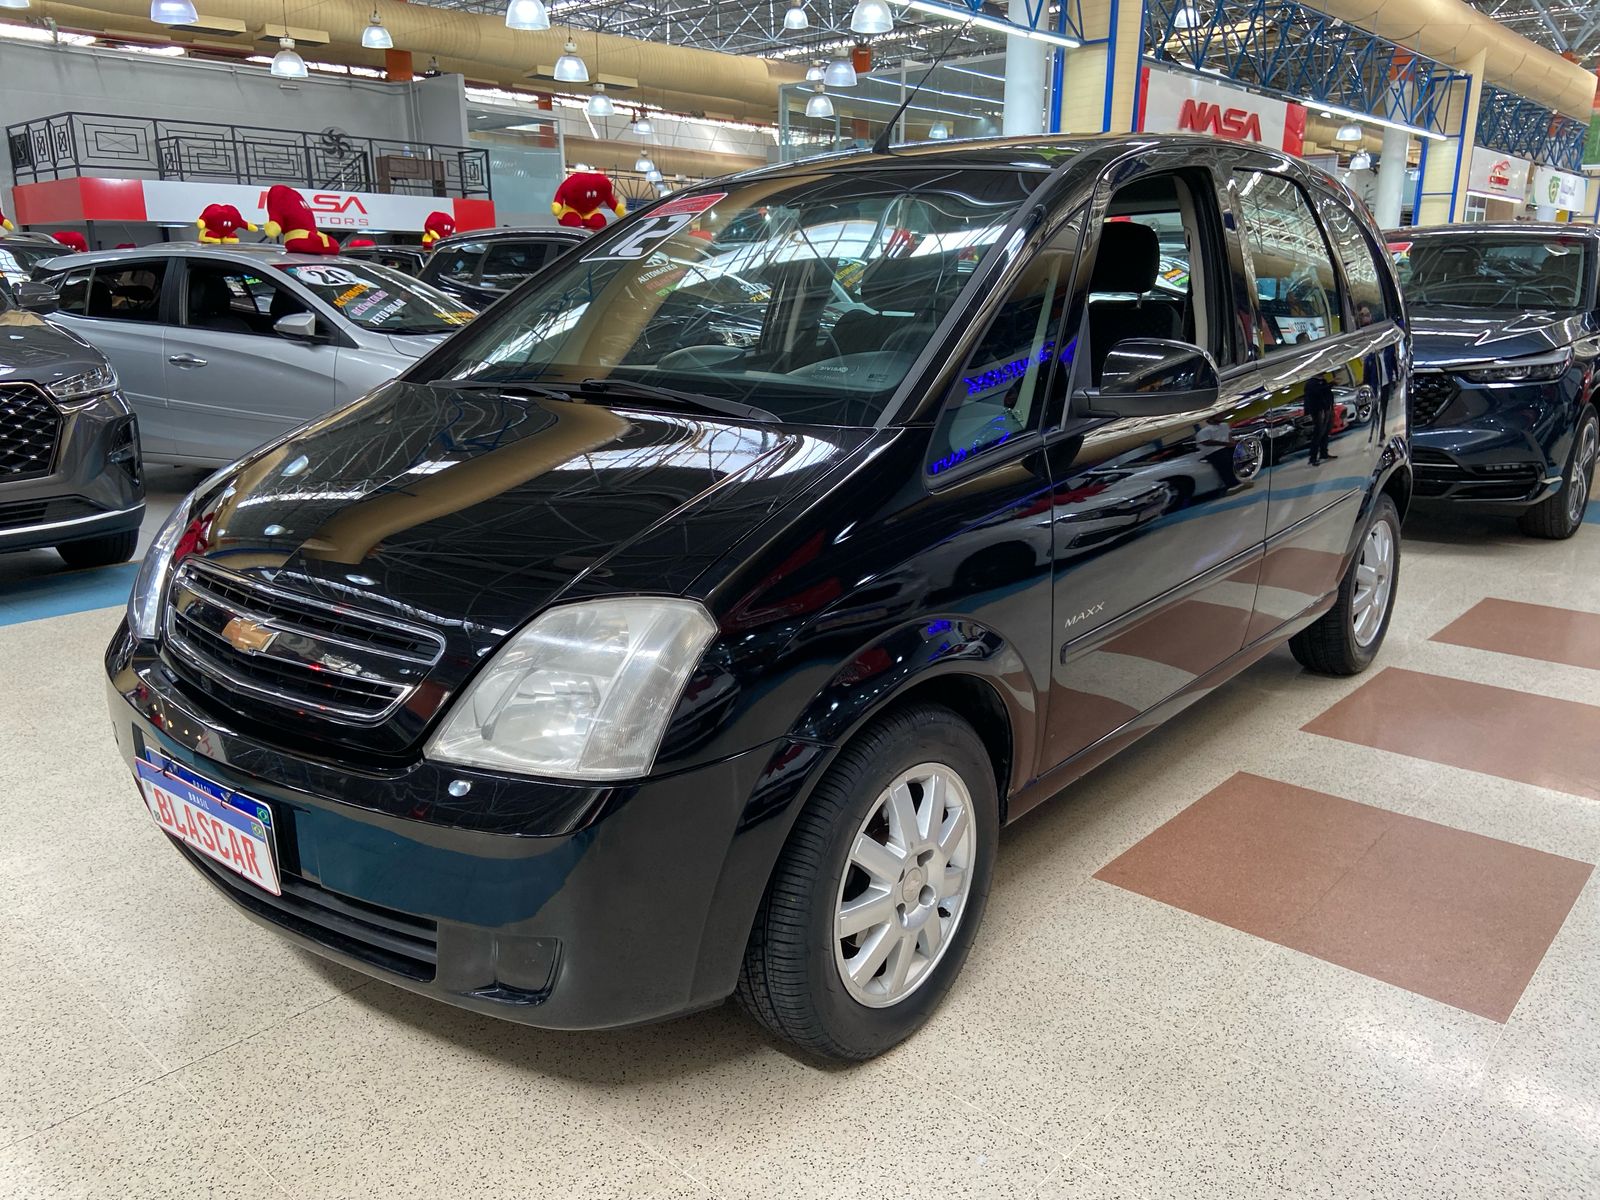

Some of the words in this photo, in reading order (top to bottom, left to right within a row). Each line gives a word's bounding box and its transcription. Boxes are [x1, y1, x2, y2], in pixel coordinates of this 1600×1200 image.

[1180, 99, 1262, 142] NASA
[608, 214, 692, 256] 12
[1064, 601, 1105, 629] MAXX
[187, 791, 210, 810] BRASIL
[153, 787, 263, 880] BLASCAR
